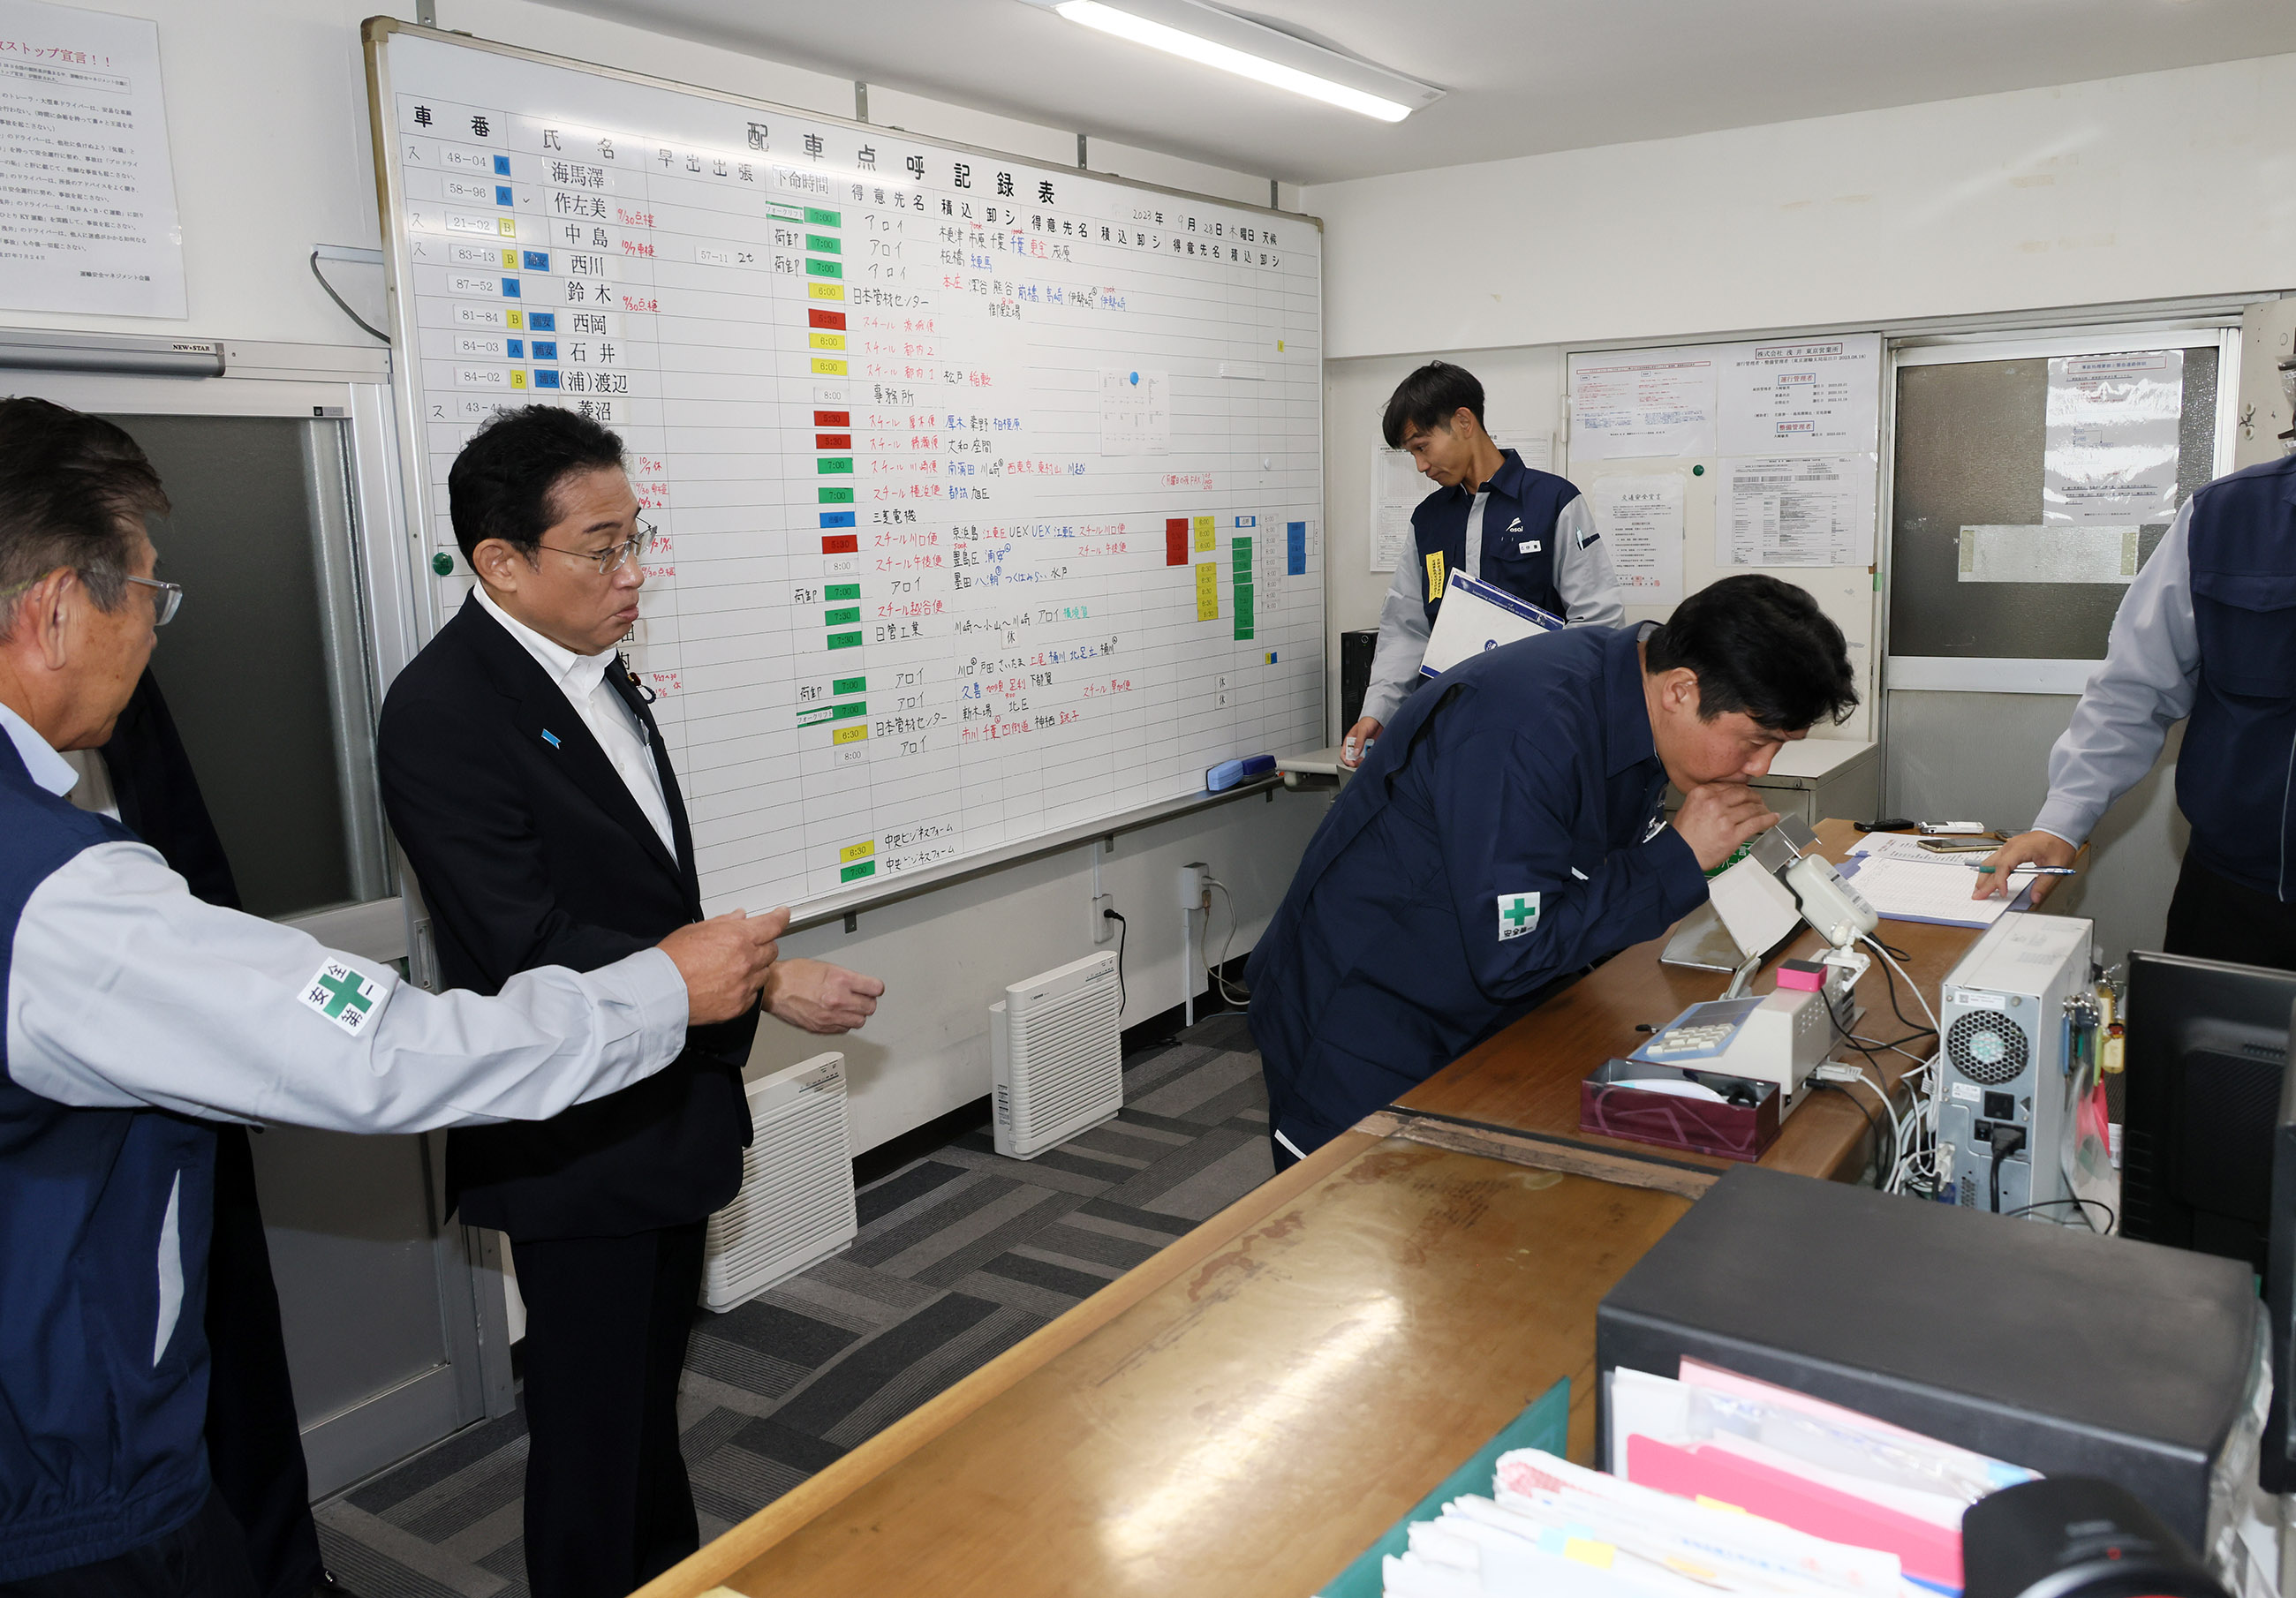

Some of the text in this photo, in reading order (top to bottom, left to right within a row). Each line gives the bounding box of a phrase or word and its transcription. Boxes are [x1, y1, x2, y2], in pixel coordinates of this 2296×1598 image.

[447, 151, 487, 167] 48-04
[747, 122, 1055, 205] 配車点呼記録表
[414, 106, 490, 138] 車番
[543, 129, 615, 160] 氏名
[851, 184, 924, 212] 得意先名
[940, 199, 972, 220] 積込
[986, 207, 1016, 225] 卸シ
[1031, 215, 1089, 238] 得意先名
[1101, 226, 1128, 245] 積込
[1137, 233, 1161, 249] 卸シ
[1173, 237, 1220, 259] 得意先名
[1230, 248, 1252, 264] 積込
[449, 183, 608, 219] 58-96 作左美
[452, 217, 491, 231] 21-02
[565, 223, 608, 249] 中島
[1262, 231, 1278, 246] 天候
[457, 248, 496, 262] 83-13
[570, 256, 605, 277] 西川
[456, 279, 494, 291] 87-52
[567, 281, 612, 303] 鈴木
[461, 311, 500, 323] 81-84
[572, 313, 608, 335] 西岡
[819, 336, 838, 347] 6:00
[462, 340, 500, 353] 84-03
[570, 342, 616, 363] 石井
[463, 371, 501, 383] 84-02
[819, 362, 838, 373] 6:00
[823, 390, 842, 401] 8:00
[834, 561, 851, 571] 8:00
[844, 750, 861, 761] 8:00
